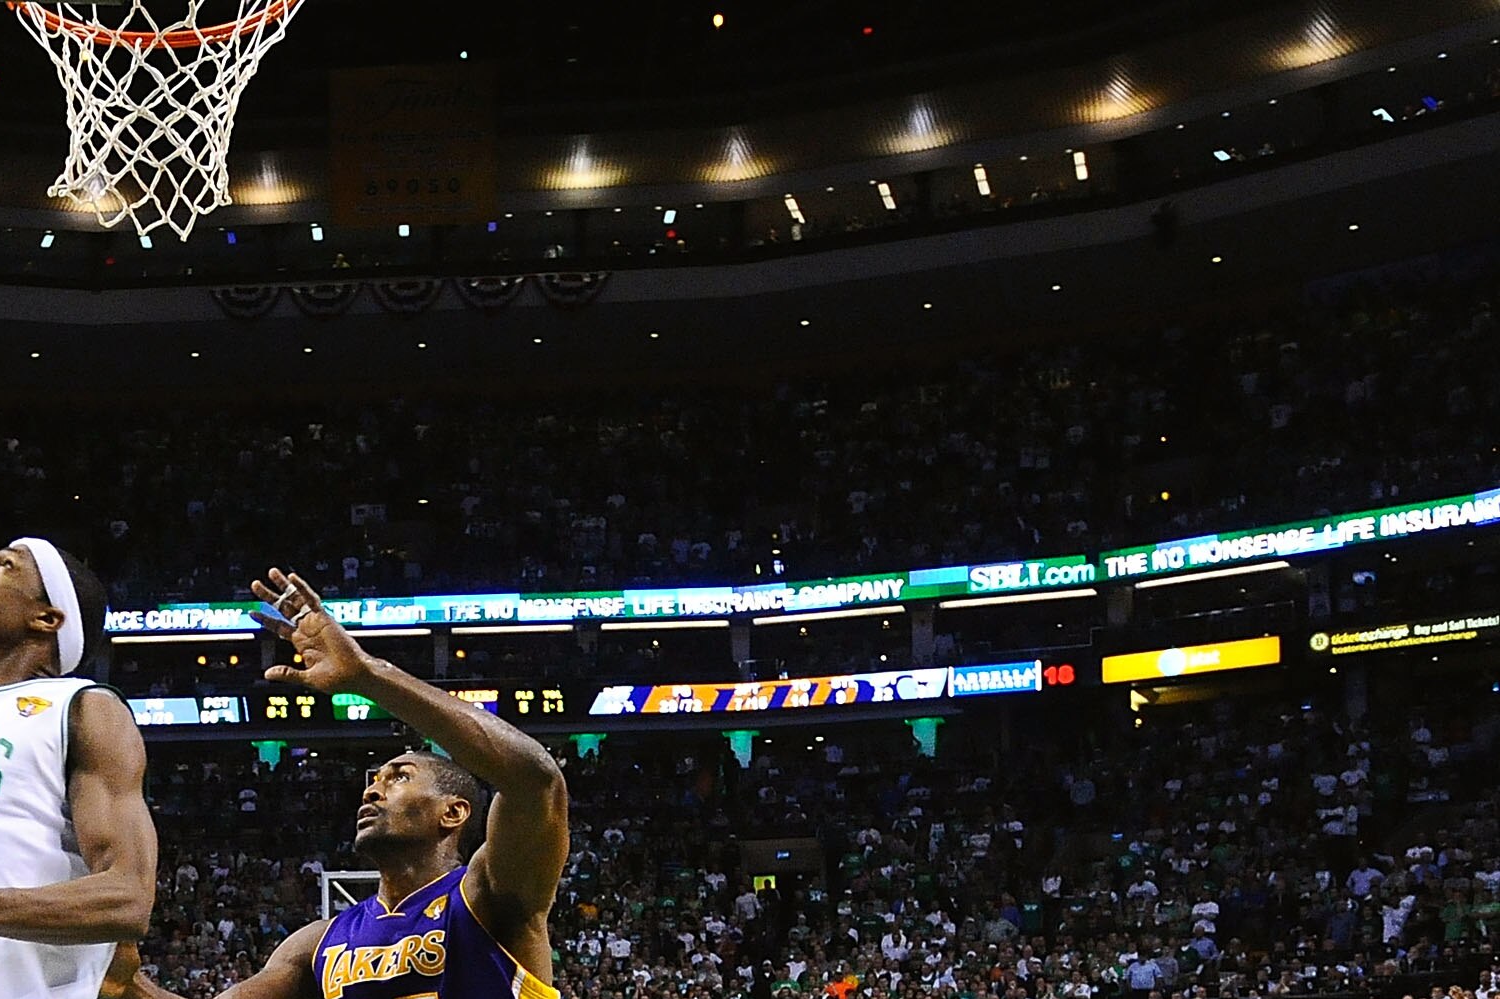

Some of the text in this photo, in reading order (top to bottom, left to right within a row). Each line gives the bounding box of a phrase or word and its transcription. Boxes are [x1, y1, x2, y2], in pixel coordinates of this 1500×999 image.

[970, 562, 1095, 591] SBLI.com
[1105, 553, 1149, 578] THE
[1152, 546, 1186, 571] NO
[1189, 527, 1316, 566] NONSENSE
[1324, 516, 1376, 545] LIFE
[145, 608, 243, 631] COMPANY
[441, 602, 482, 621] THE
[484, 601, 516, 620] NO
[632, 594, 676, 615] LIFE
[798, 578, 905, 607] COMPANY
